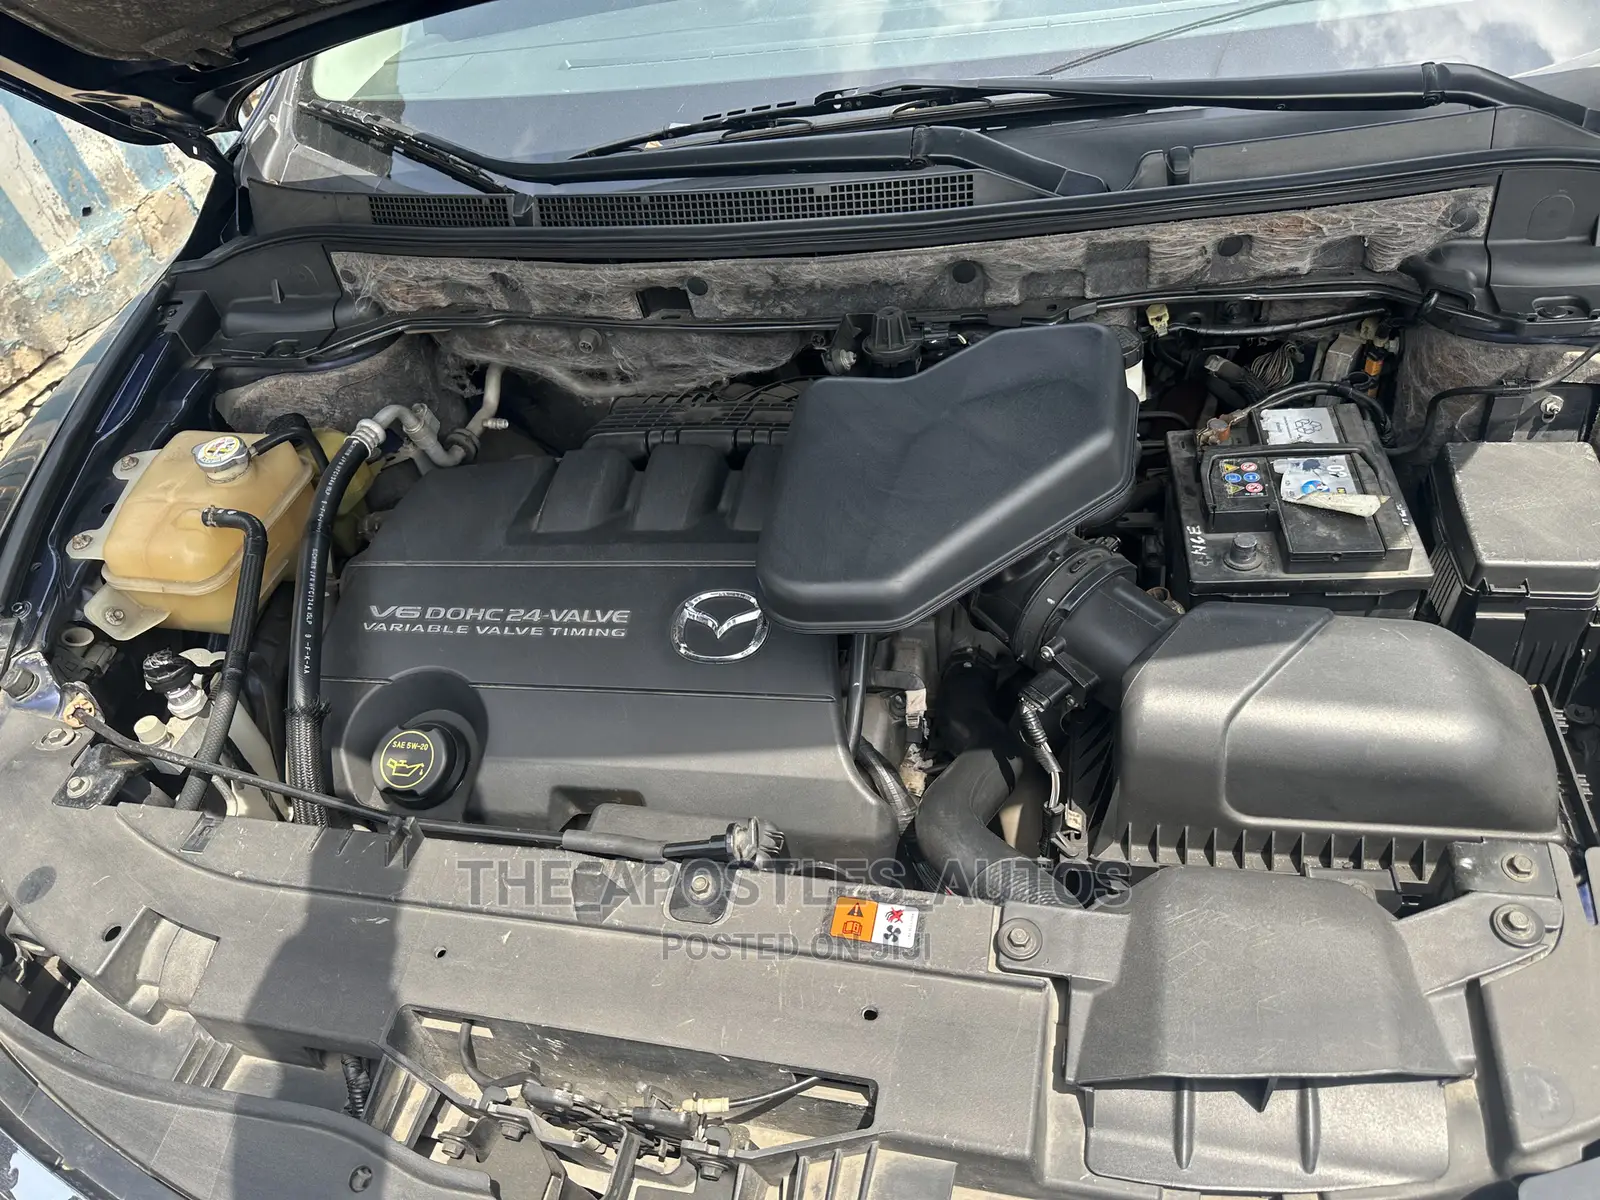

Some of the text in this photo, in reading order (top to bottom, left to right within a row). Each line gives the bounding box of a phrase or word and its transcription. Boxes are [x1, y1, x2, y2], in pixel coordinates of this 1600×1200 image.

[369, 605, 631, 624] V6 DOHC 24-VALVE
[363, 622, 627, 638] VARIABLE VALVE TIMING
[392, 741, 429, 751] SAE 5W-20
